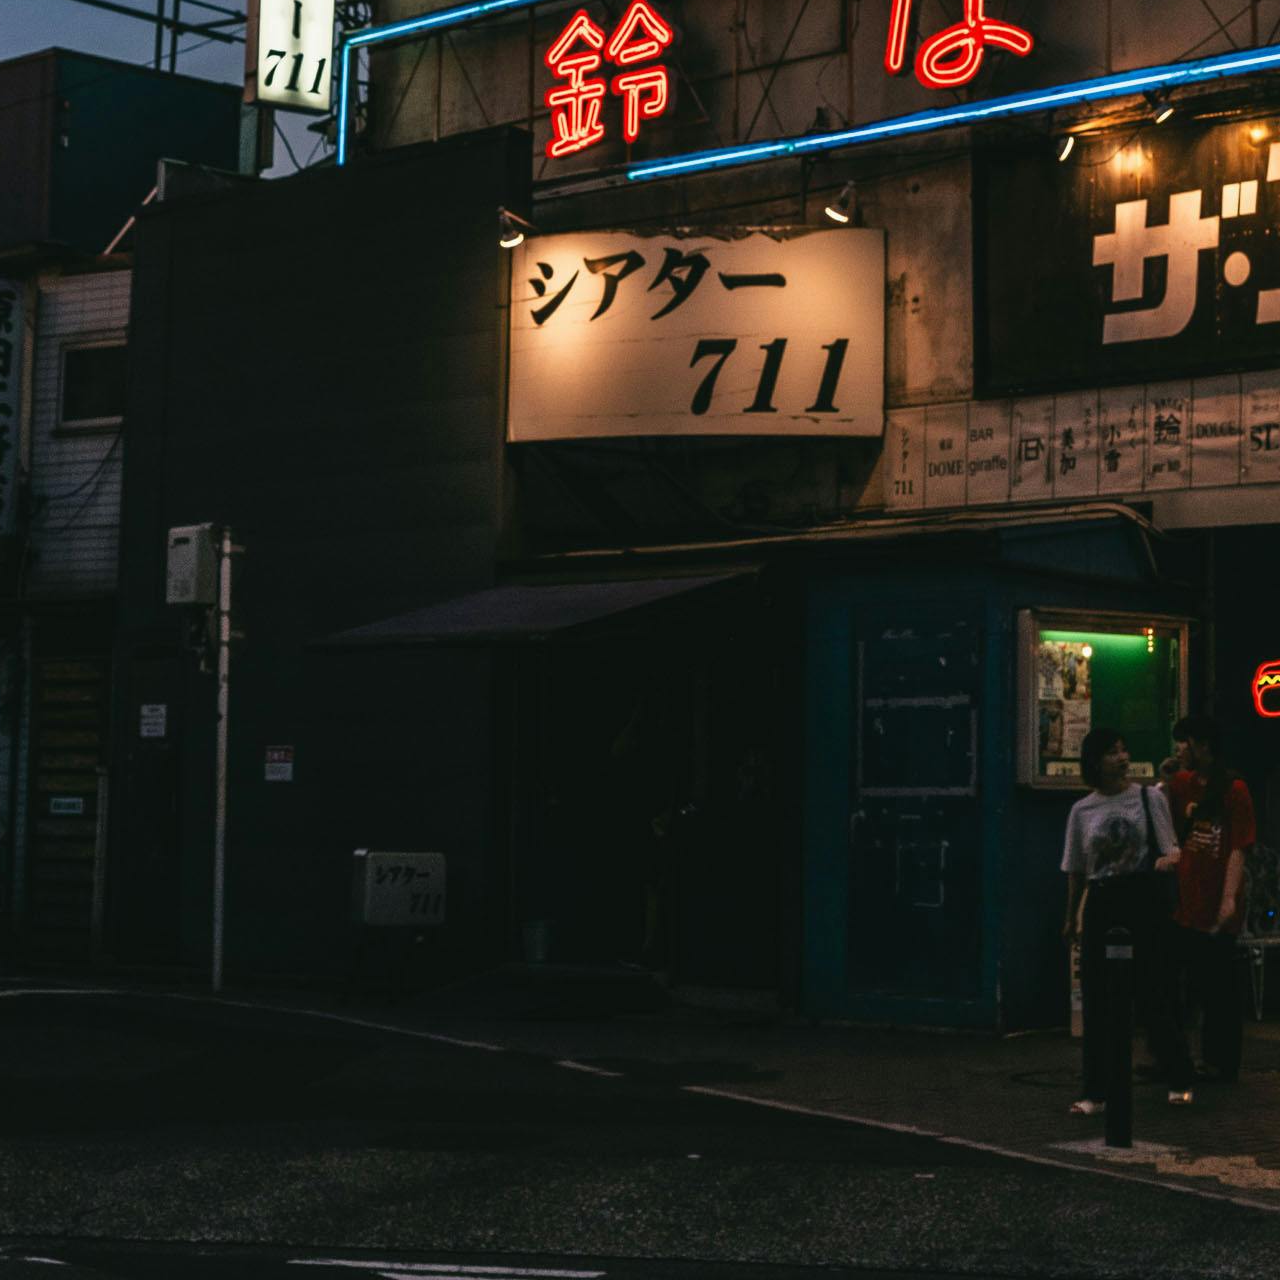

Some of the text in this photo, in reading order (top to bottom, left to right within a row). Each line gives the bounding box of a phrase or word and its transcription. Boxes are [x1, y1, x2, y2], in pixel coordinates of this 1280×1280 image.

[263, 49, 327, 96] 711
[528, 247, 787, 326] シアター
[689, 337, 850, 416] 711
[969, 428, 994, 441] BAR
[928, 460, 965, 478] DOME
[969, 456, 1008, 477] giraffe
[894, 480, 914, 495] 711
[375, 865, 431, 885] シアター
[409, 893, 443, 915] 711
